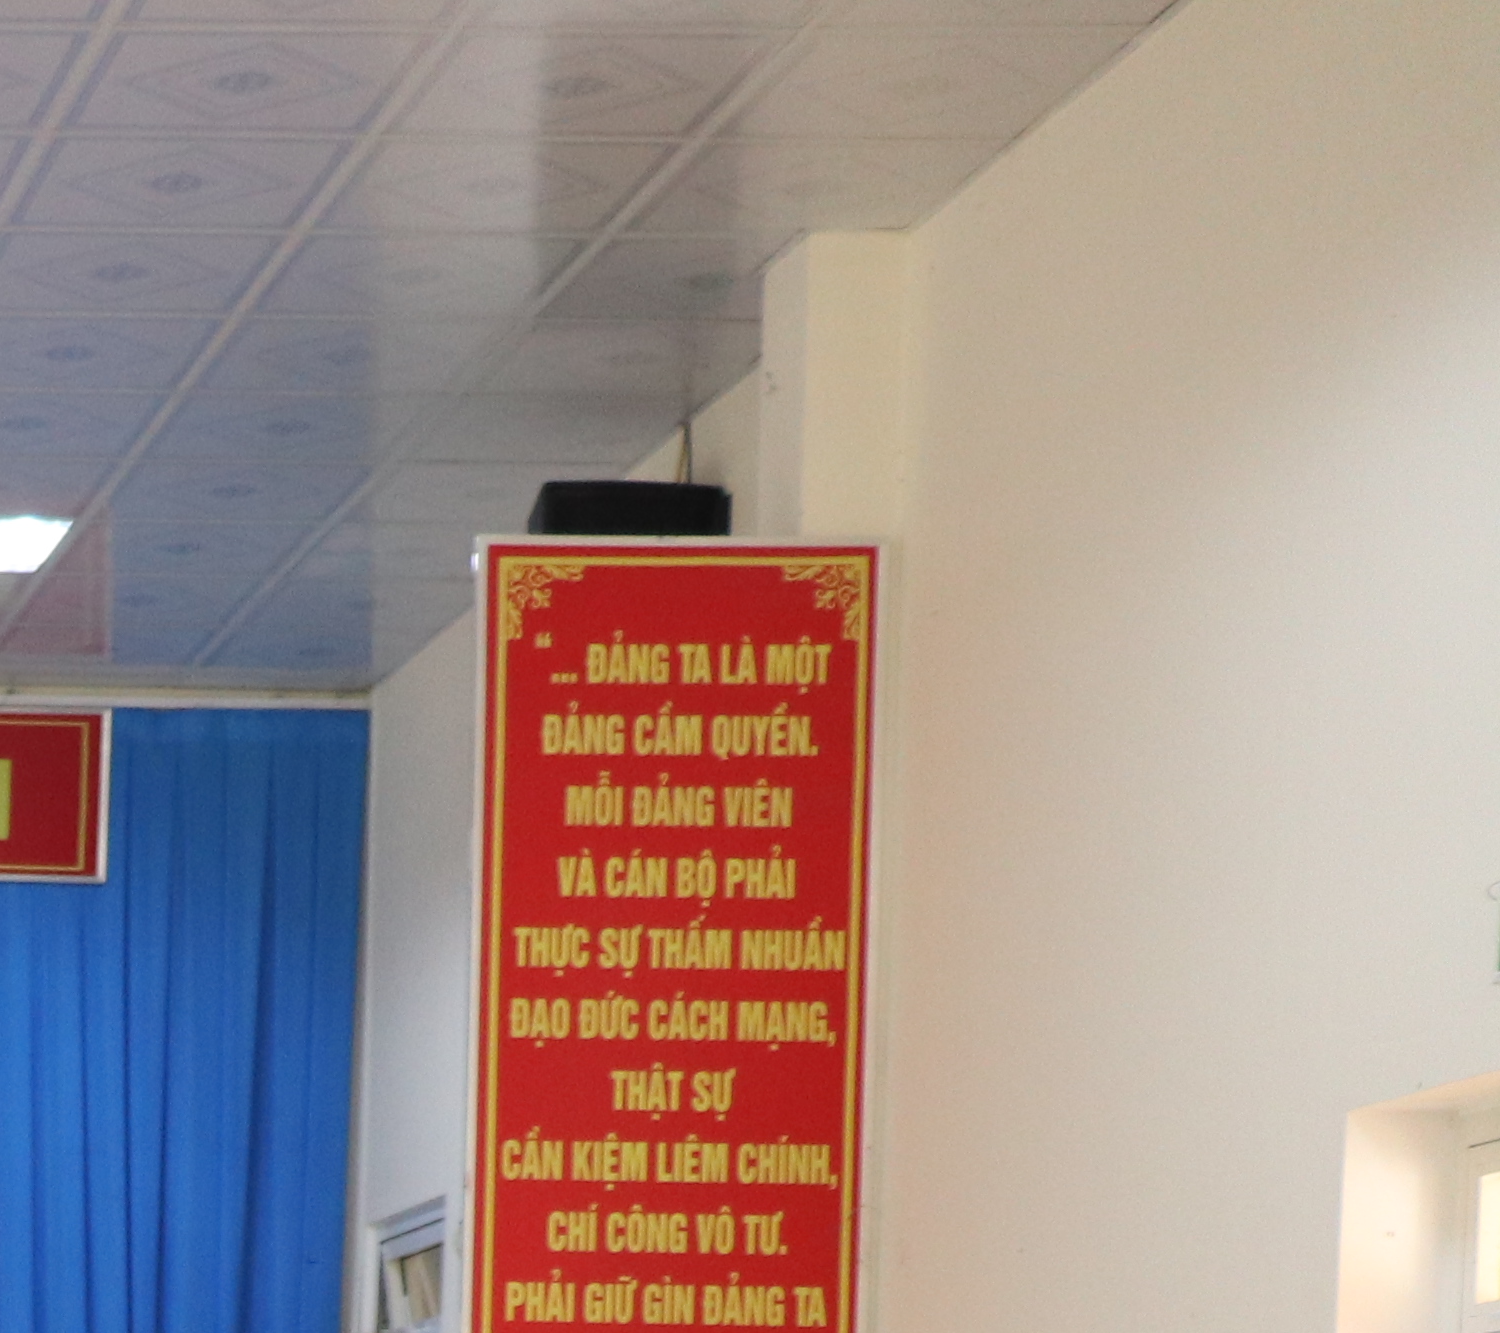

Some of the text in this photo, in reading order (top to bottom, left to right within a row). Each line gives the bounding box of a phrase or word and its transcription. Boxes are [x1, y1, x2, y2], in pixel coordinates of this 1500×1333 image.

[586, 630, 832, 693] ĐẢNG TA LÀ MỘT
[565, 771, 793, 827] MỖI ĐẢNG VIÊN
[558, 845, 796, 907] VÀ CÁN BỘ PHẢI
[514, 924, 591, 976] THỰC
[598, 925, 644, 977] SỰ
[647, 915, 733, 969] THẤM
[509, 991, 836, 1050] ĐẠO ĐỨC CÁCH MẠNG,
[610, 1062, 736, 1121] THẬT SỰ
[547, 1204, 598, 1251] CHÍ
[606, 1204, 688, 1253] CÔNG
[696, 1206, 735, 1254] VÔ
[505, 1269, 827, 1327] PHẢI GIỮ GÌN ĐẢNG TA
